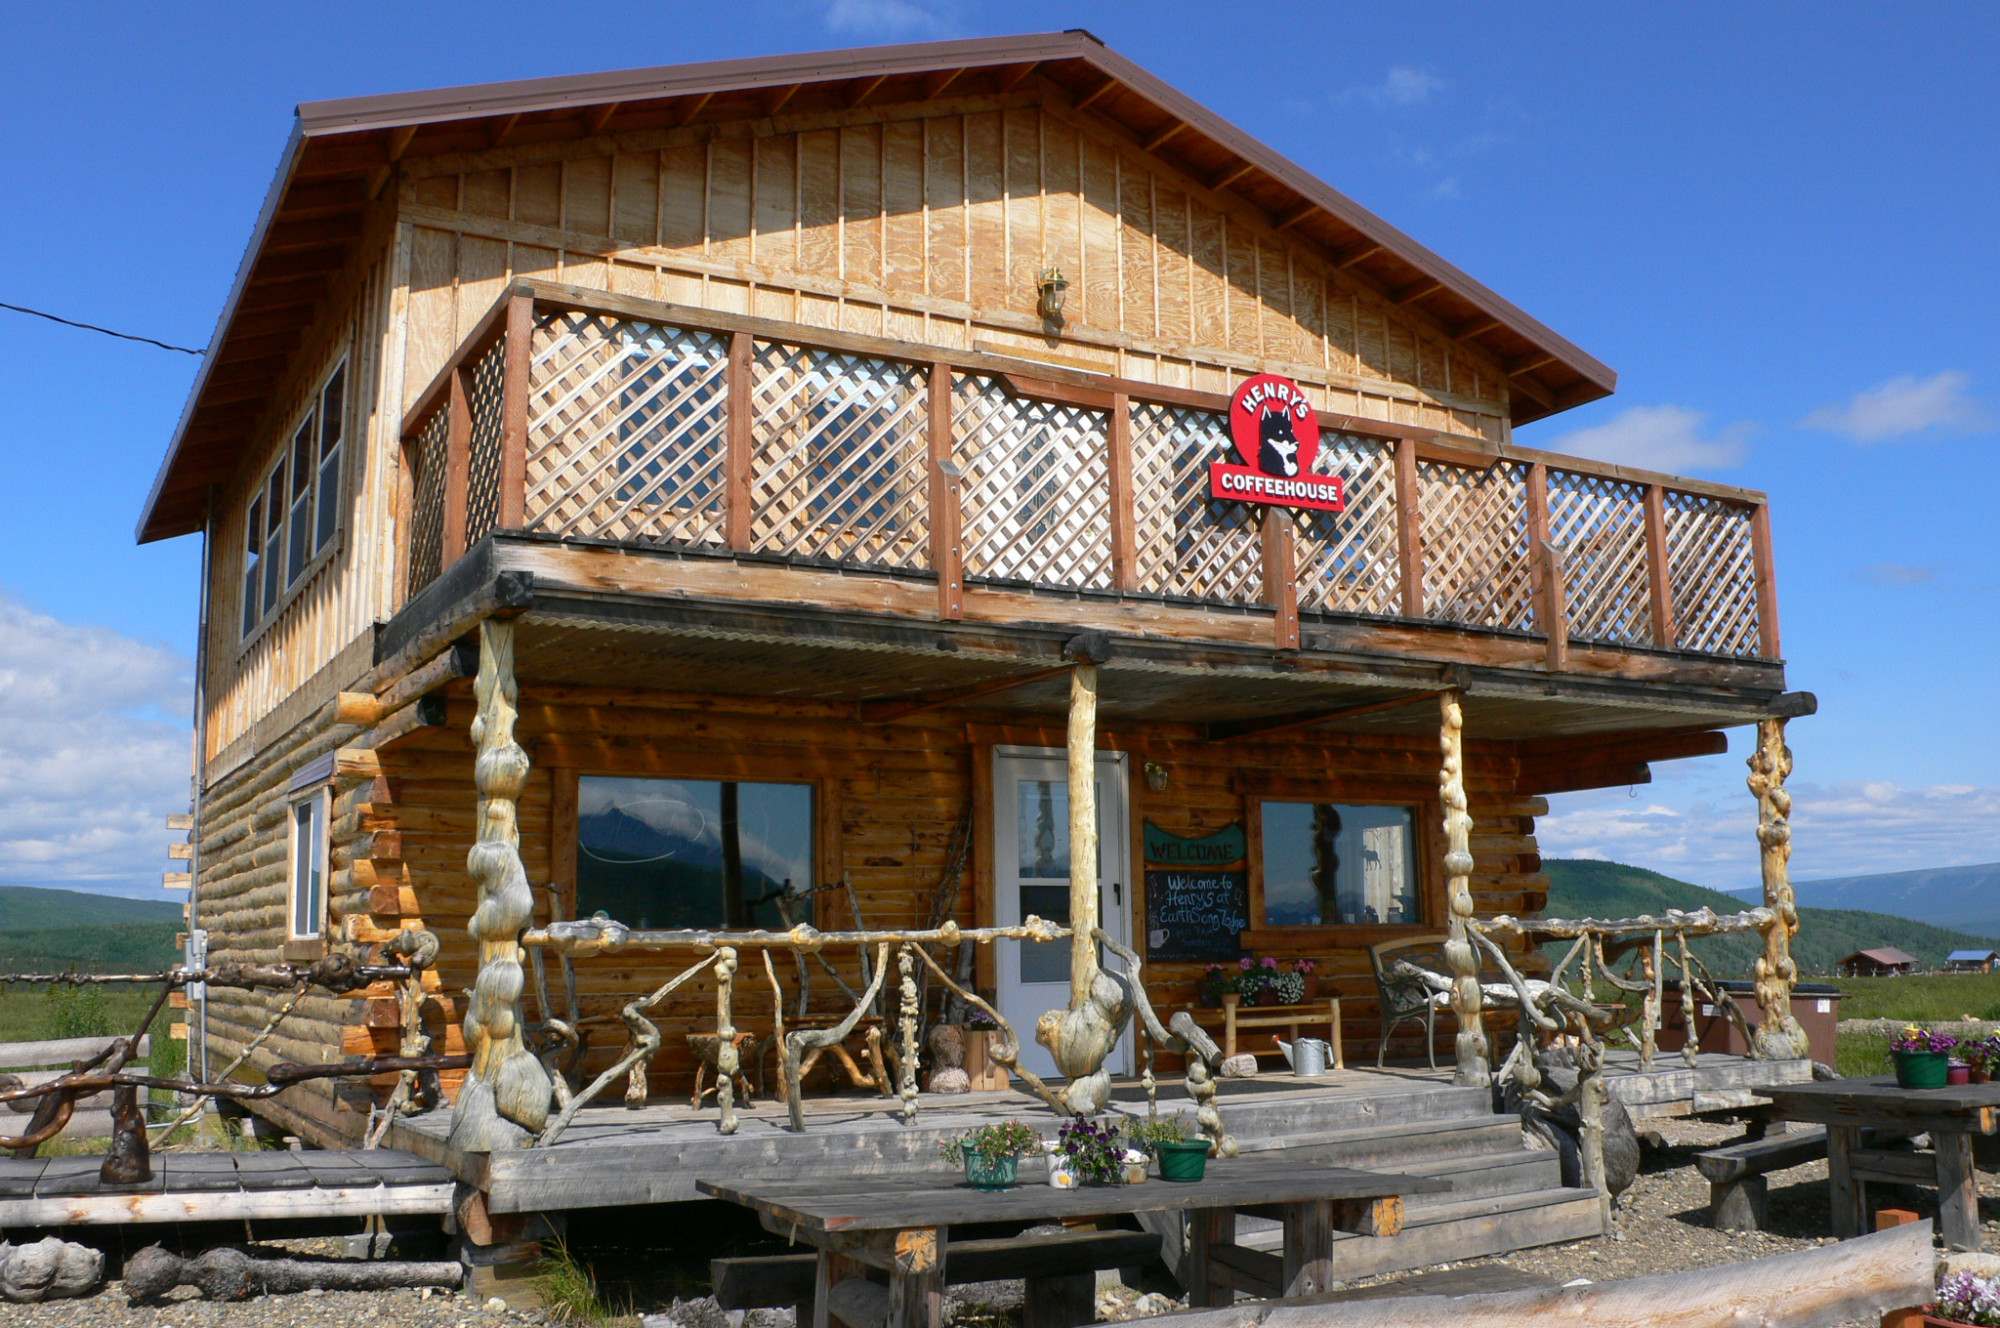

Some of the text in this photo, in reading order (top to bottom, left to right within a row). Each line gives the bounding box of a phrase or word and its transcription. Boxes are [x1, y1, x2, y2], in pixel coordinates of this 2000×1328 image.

[1241, 382, 1309, 419] HENRY'S
[1221, 473, 1338, 501] COFFEEHOUSE
[1150, 841, 1235, 860] WELCOME
[1167, 874, 1233, 890] Welcome to
[1216, 891, 1231, 905] at
